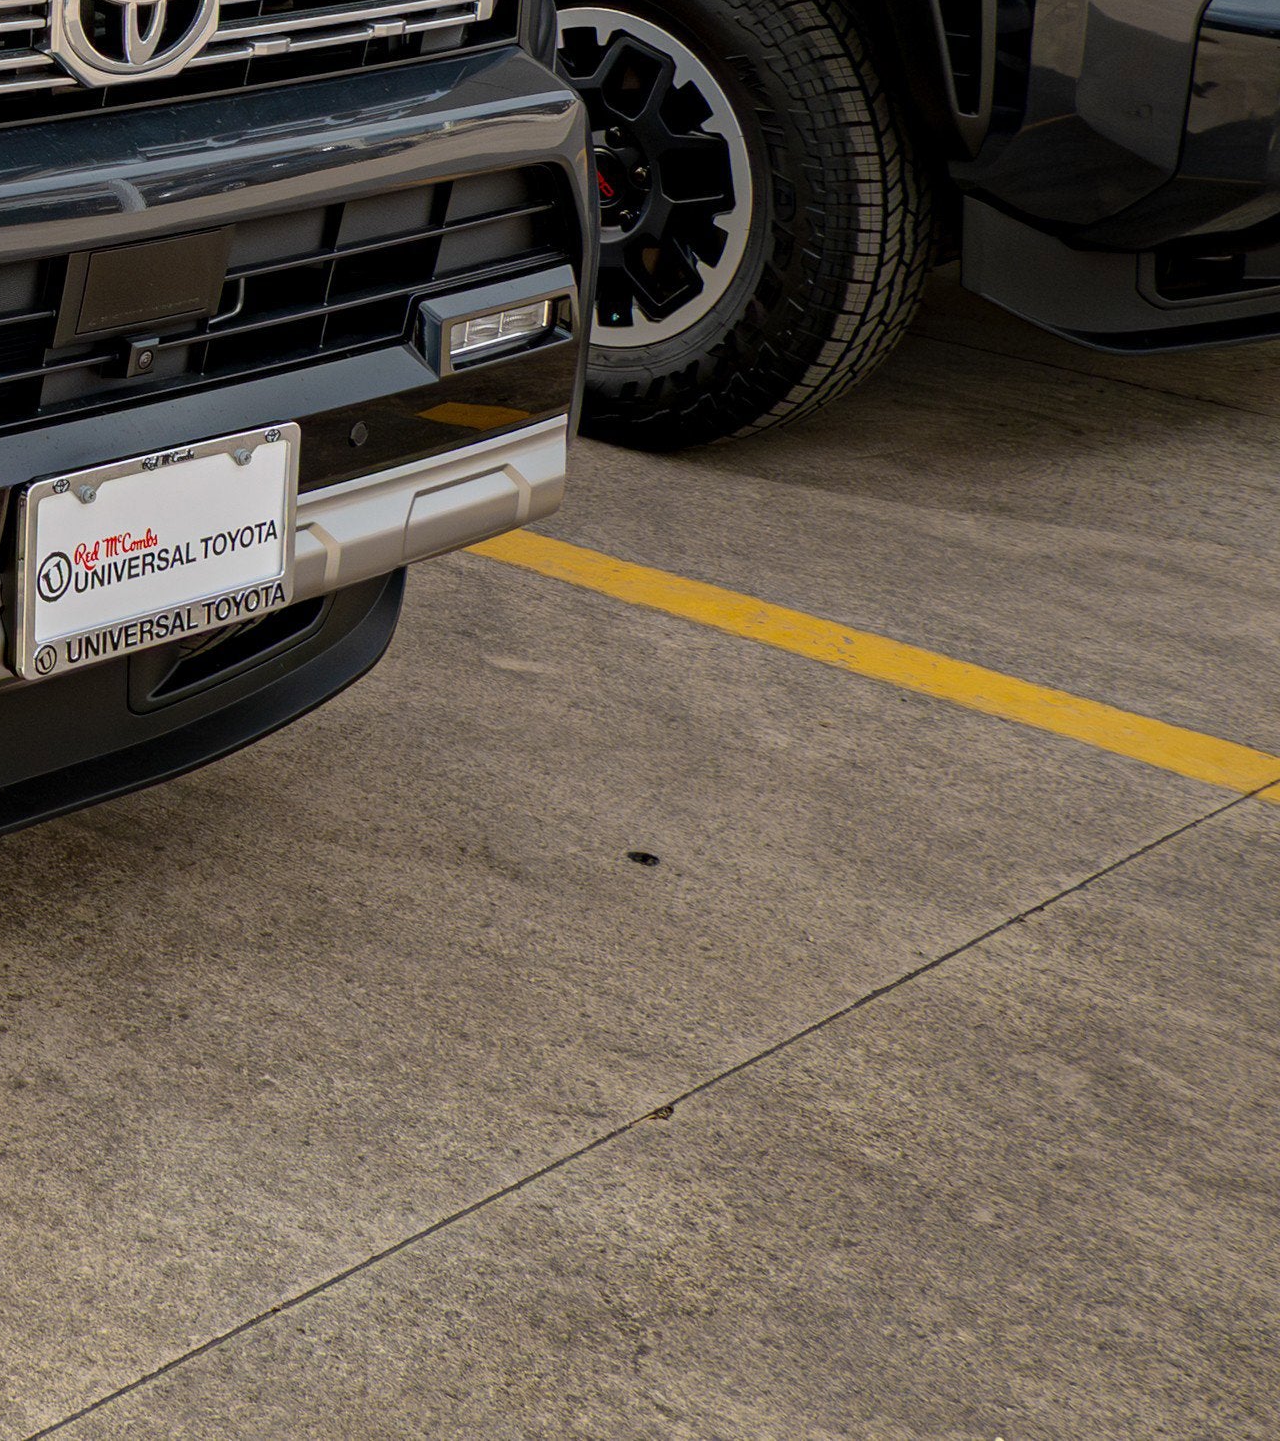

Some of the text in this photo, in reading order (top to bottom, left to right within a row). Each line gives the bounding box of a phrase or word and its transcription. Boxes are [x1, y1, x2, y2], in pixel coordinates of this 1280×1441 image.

[74, 528, 158, 571] Red McCombs
[74, 542, 197, 594] UNIVERSAL
[200, 519, 278, 559] TOYOTA
[66, 609, 199, 664] UNIVERSAL
[202, 580, 286, 625] TOYOTA
